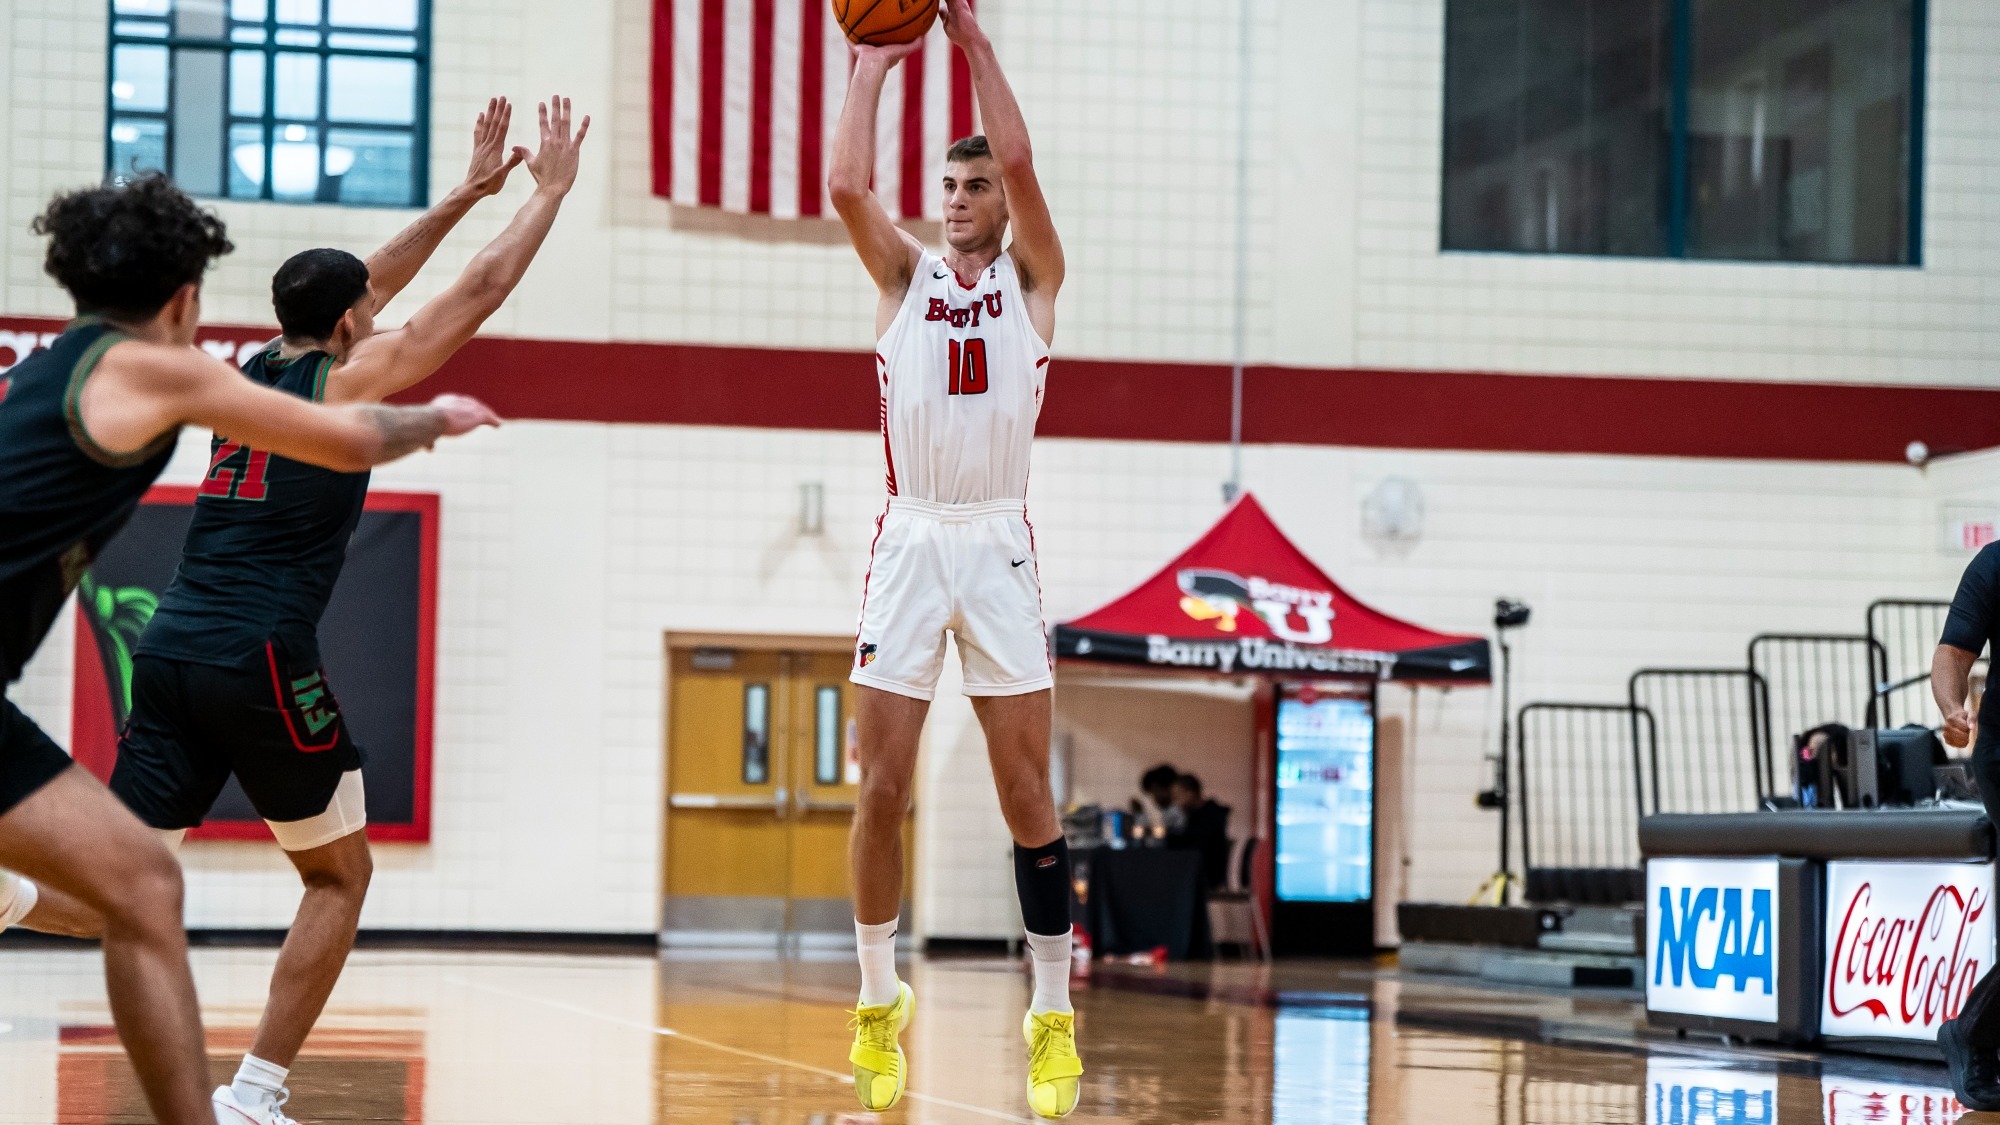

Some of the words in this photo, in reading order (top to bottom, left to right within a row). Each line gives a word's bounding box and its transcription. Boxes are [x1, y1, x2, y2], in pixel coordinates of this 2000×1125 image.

[983, 290, 1002, 318] U
[948, 338, 988, 395] 10
[196, 432, 271, 501] 21
[1147, 634, 1238, 673] Barry
[1239, 637, 1398, 680] University
[1655, 886, 1773, 995] NCAA
